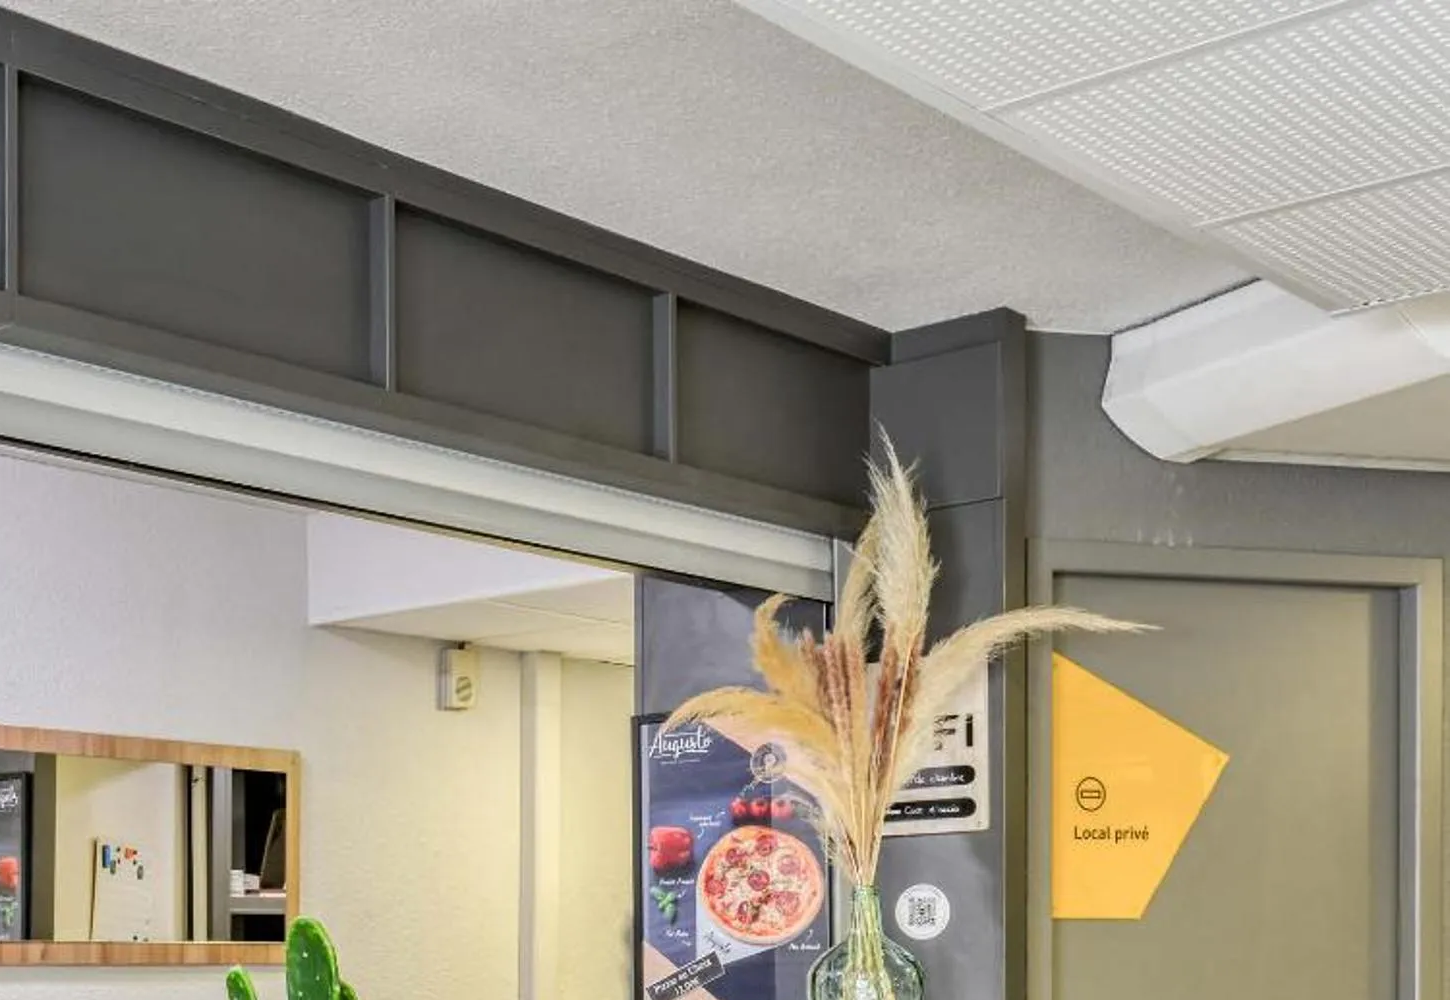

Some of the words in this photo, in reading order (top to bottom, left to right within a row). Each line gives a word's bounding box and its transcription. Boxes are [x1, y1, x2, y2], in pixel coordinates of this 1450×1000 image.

[649, 724, 713, 759] Augusto
[1073, 824, 1111, 840] Local
[1114, 824, 1150, 845] privé
